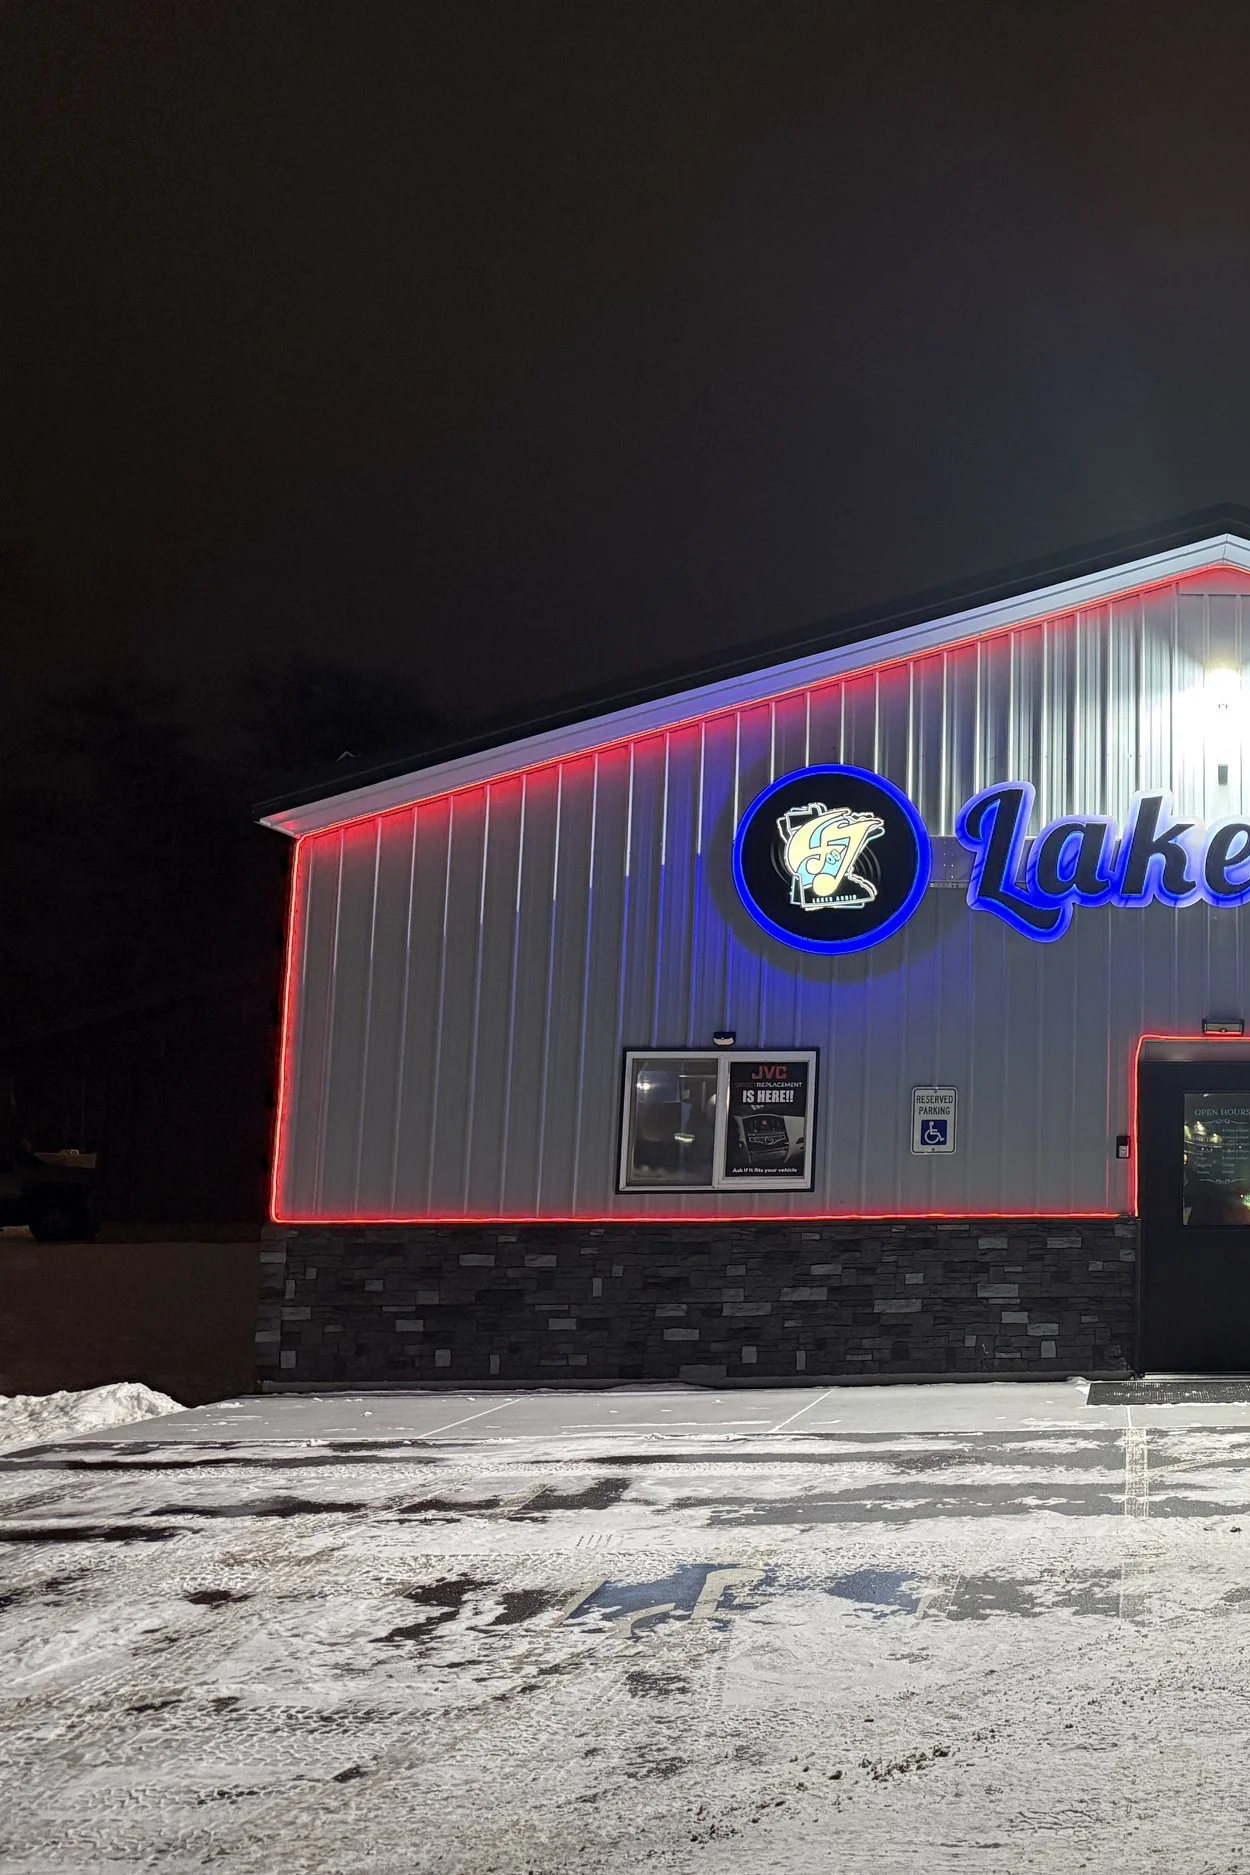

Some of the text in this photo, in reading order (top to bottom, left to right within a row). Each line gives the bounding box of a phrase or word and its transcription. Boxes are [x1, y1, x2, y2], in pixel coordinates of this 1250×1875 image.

[752, 1066, 787, 1080] JVC
[742, 1090, 794, 1103] IS HERE!!
[916, 1095, 953, 1104] RESERVED
[918, 1107, 951, 1116] PARKING
[1194, 1108, 1218, 1116] OPEN
